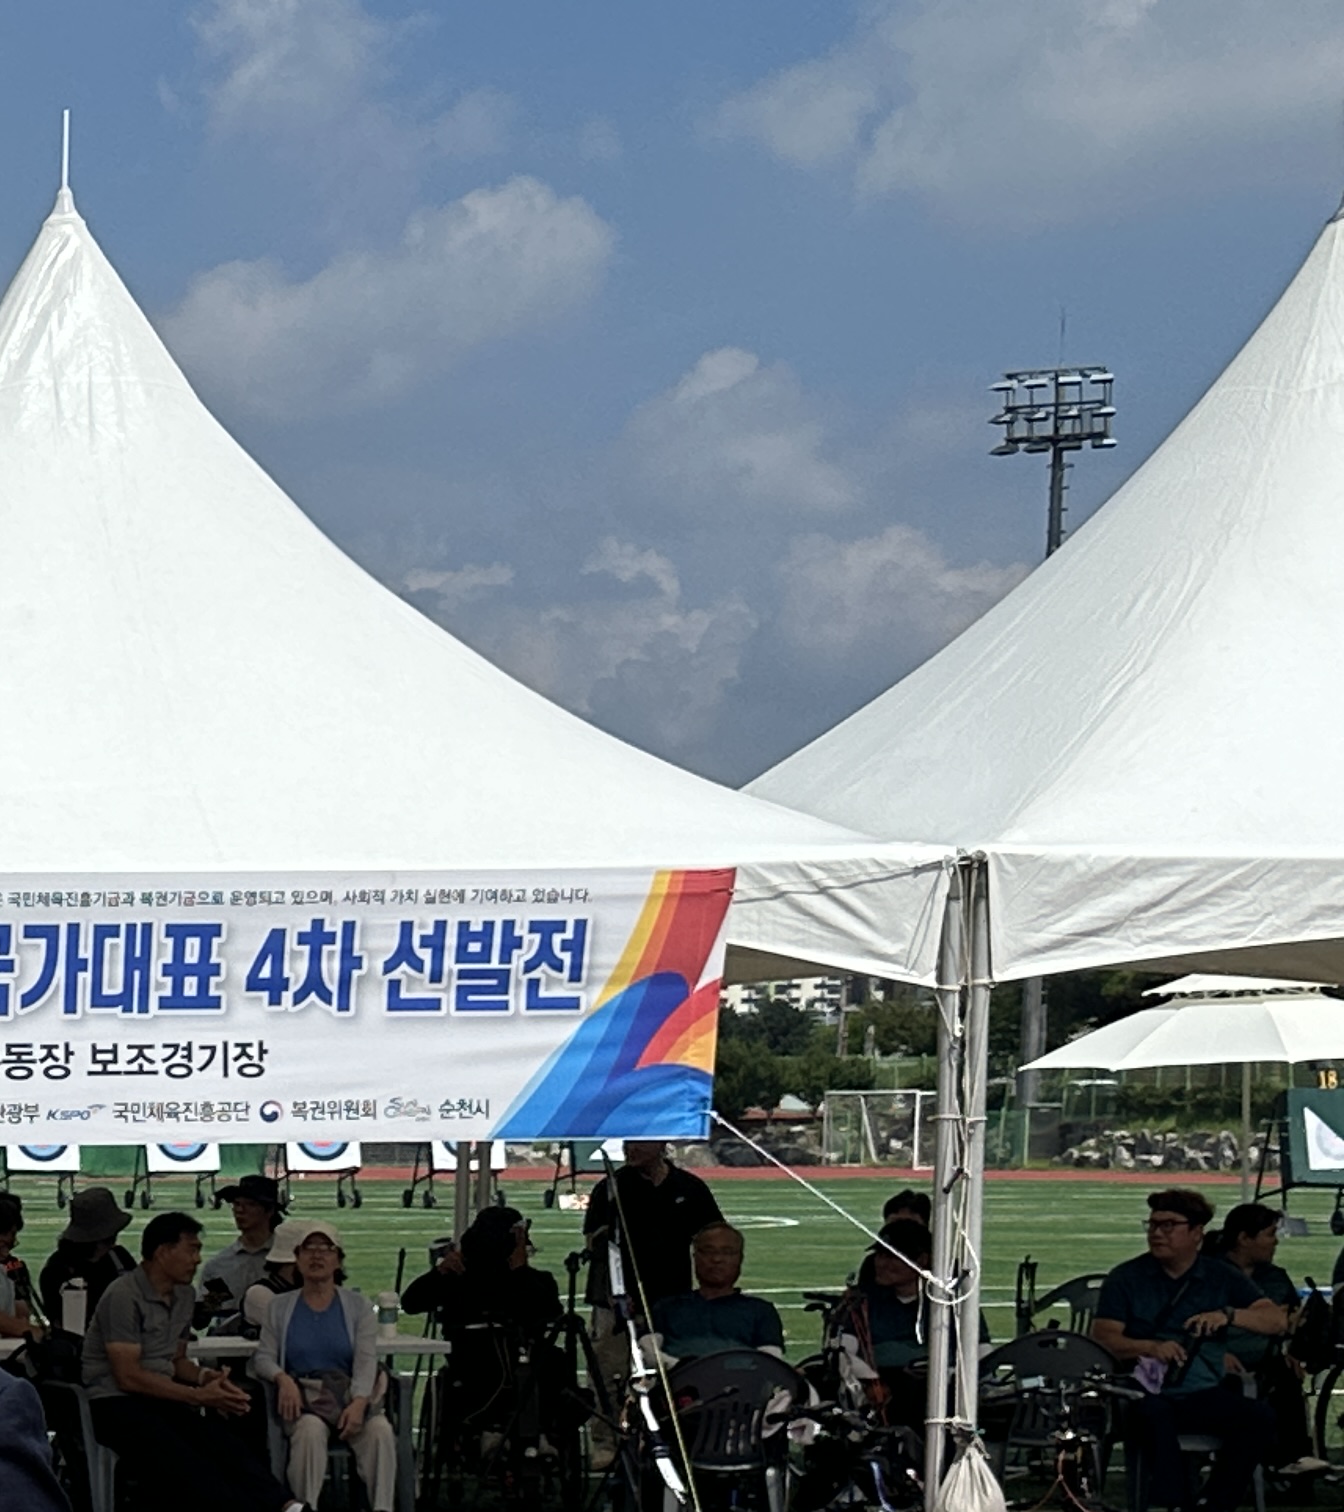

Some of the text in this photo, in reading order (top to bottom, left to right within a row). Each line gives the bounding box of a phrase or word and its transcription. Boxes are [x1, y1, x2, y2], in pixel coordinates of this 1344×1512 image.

[7, 891, 137, 909] 국민체육진흥기금과
[230, 890, 287, 908] 운영되고
[342, 889, 387, 907] 사회적
[390, 889, 419, 907] 가치
[424, 889, 467, 906] 실현에
[471, 888, 528, 906] 기여하고
[245, 918, 365, 1014] 4차
[382, 917, 591, 1013] 선발전
[87, 1040, 270, 1080] 보조경기장
[46, 1107, 93, 1122] KSPO
[112, 1101, 252, 1124] 국민체육진흥공단
[290, 1099, 378, 1123] 복권위원회
[438, 1098, 491, 1121] 순천시
